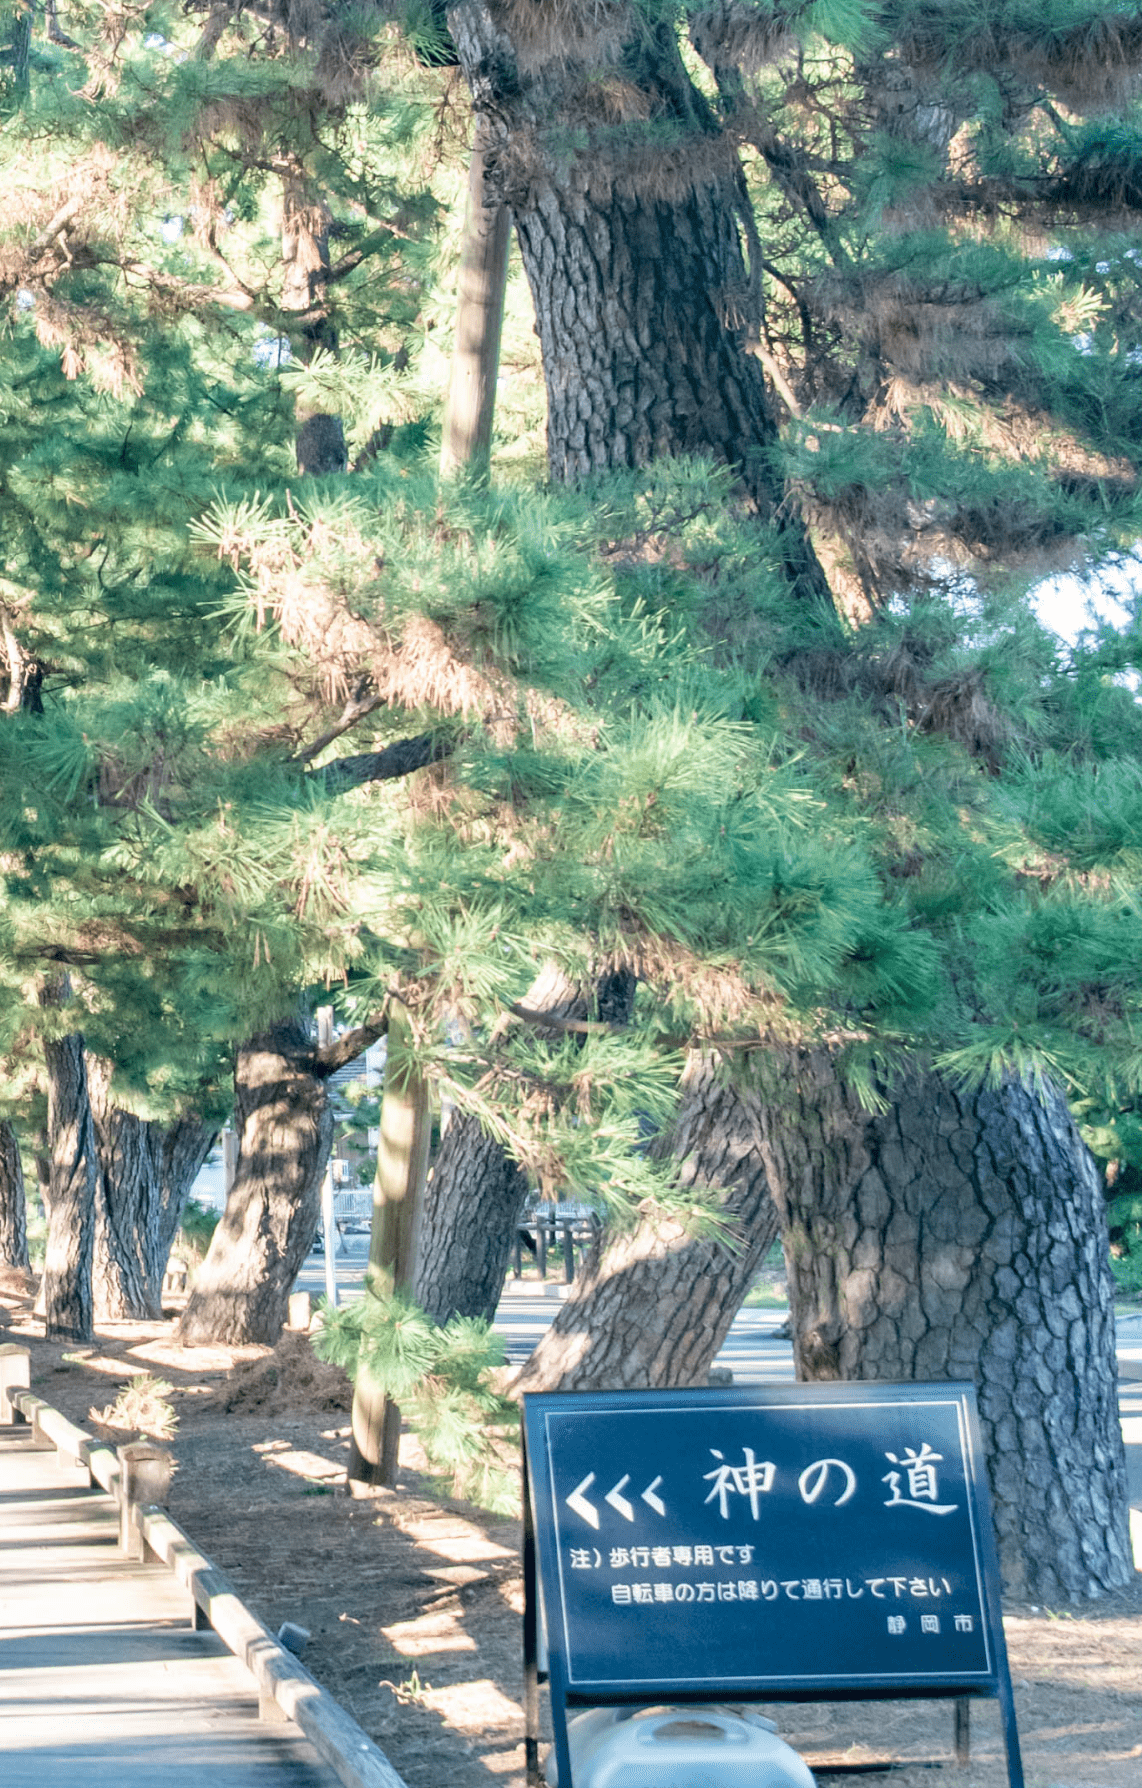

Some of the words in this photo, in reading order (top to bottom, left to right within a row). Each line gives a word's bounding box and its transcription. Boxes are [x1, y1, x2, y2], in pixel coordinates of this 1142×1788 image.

[703, 1442, 958, 1521] 神の道
[611, 1576, 952, 1605] 自転車の方は降りて通行して下さい
[887, 1614, 974, 1635] 静岡市
